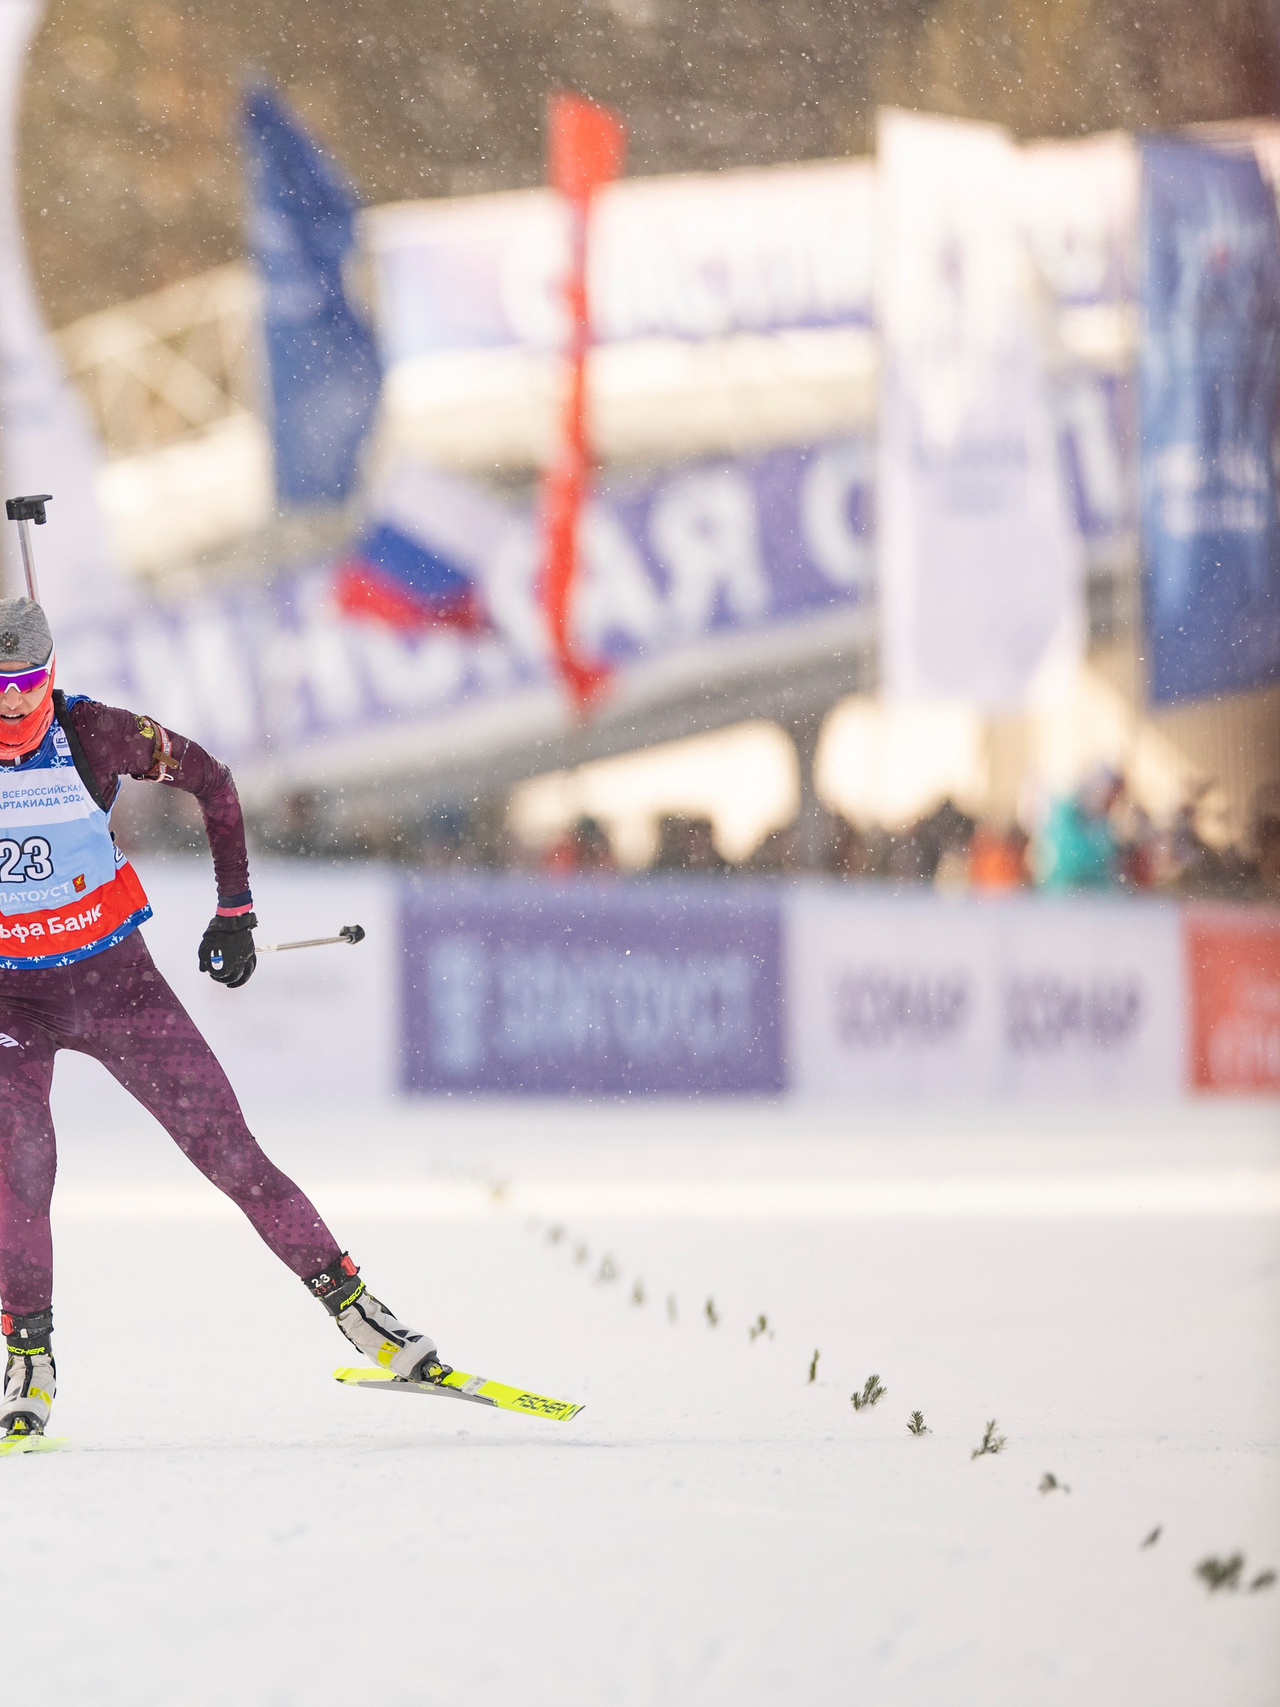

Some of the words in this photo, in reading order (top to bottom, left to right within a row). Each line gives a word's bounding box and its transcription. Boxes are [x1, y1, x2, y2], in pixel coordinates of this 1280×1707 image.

[47, 903, 103, 935] Банк
[311, 1273, 331, 1288] 23
[511, 1393, 568, 1416] FISCHER
